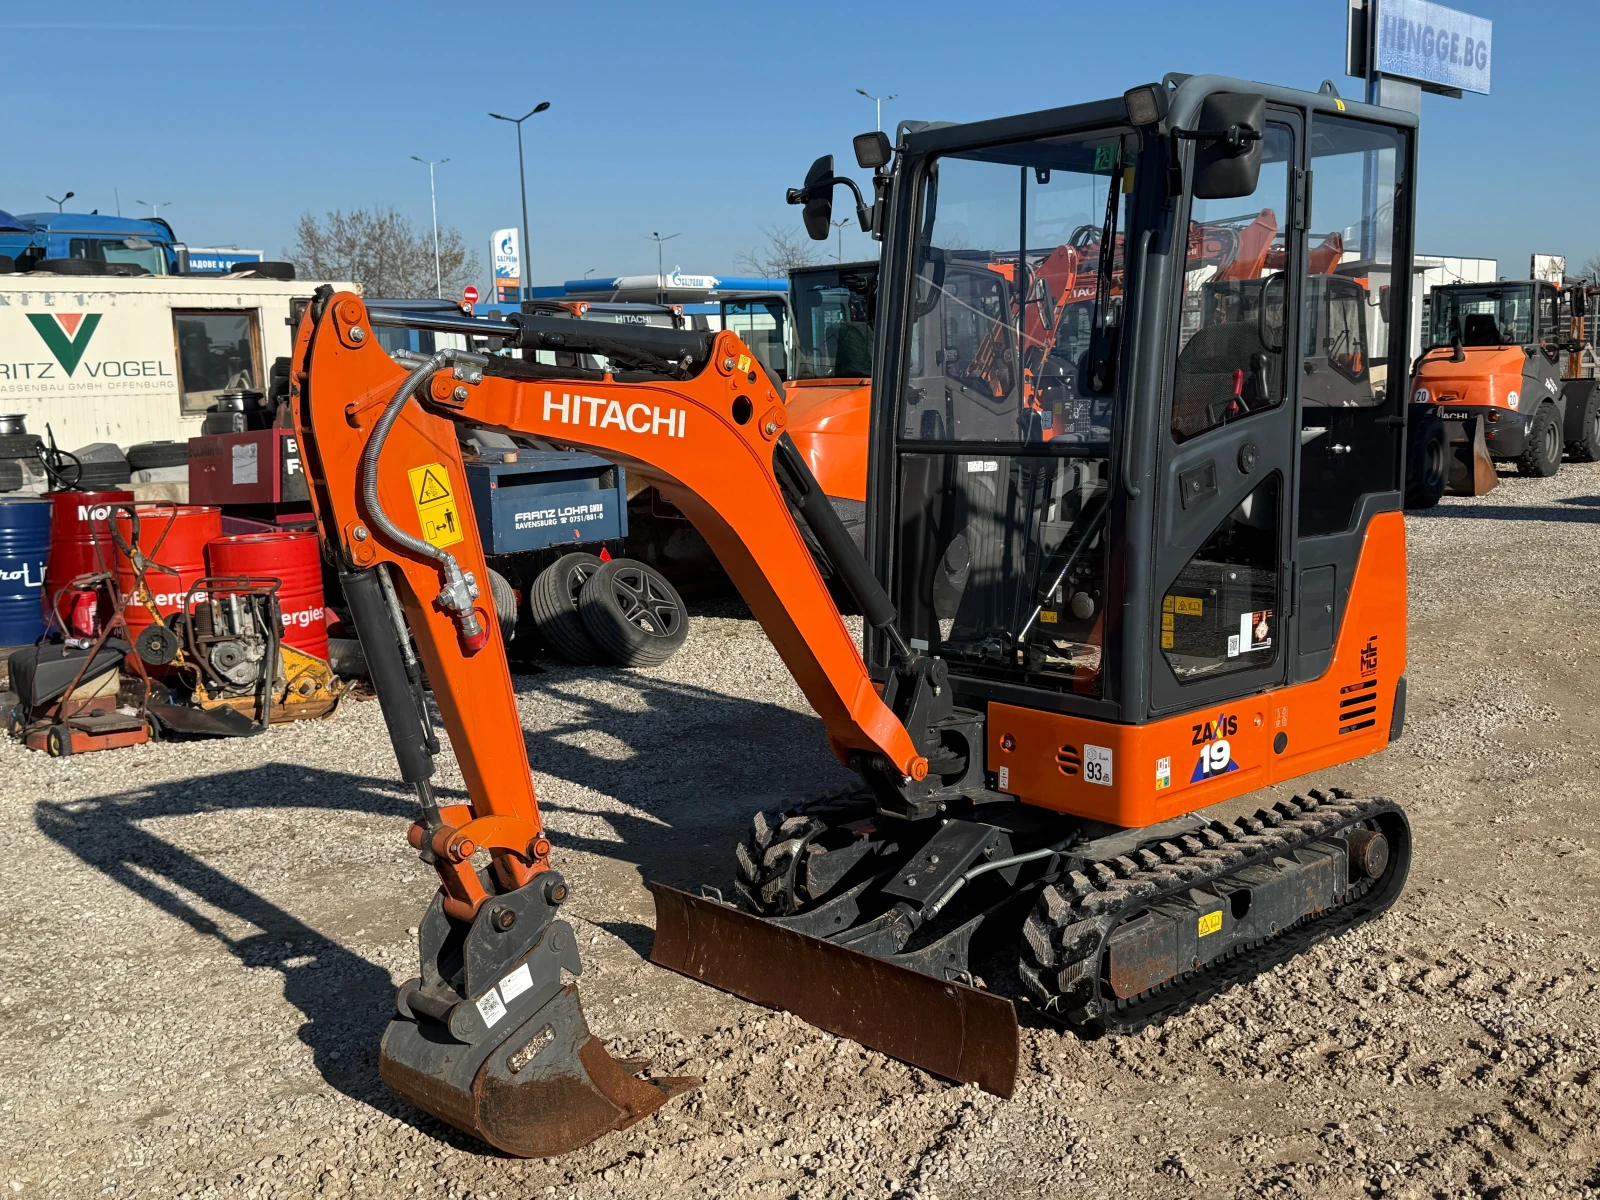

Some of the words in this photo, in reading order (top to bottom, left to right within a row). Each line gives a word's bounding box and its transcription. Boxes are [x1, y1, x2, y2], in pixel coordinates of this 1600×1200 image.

[1382, 14, 1487, 70] HENGGE.BG
[615, 315, 652, 324] HITACHI
[84, 361, 172, 378] VOGEL
[68, 382, 102, 390] GMBH
[107, 380, 174, 390] OFFENBURG
[1416, 391, 1427, 402] 20
[1509, 395, 1517, 406] 20
[542, 390, 686, 438] HITACHI
[514, 508, 556, 522] FRANZ
[557, 505, 588, 517] LOHR
[515, 518, 558, 530] RAVENSBURG
[281, 605, 325, 628] ergies
[1192, 713, 1238, 746] ZAXIS
[1200, 739, 1231, 779] 19
[1087, 761, 1102, 781] 93
[1102, 773, 1110, 783] dB
